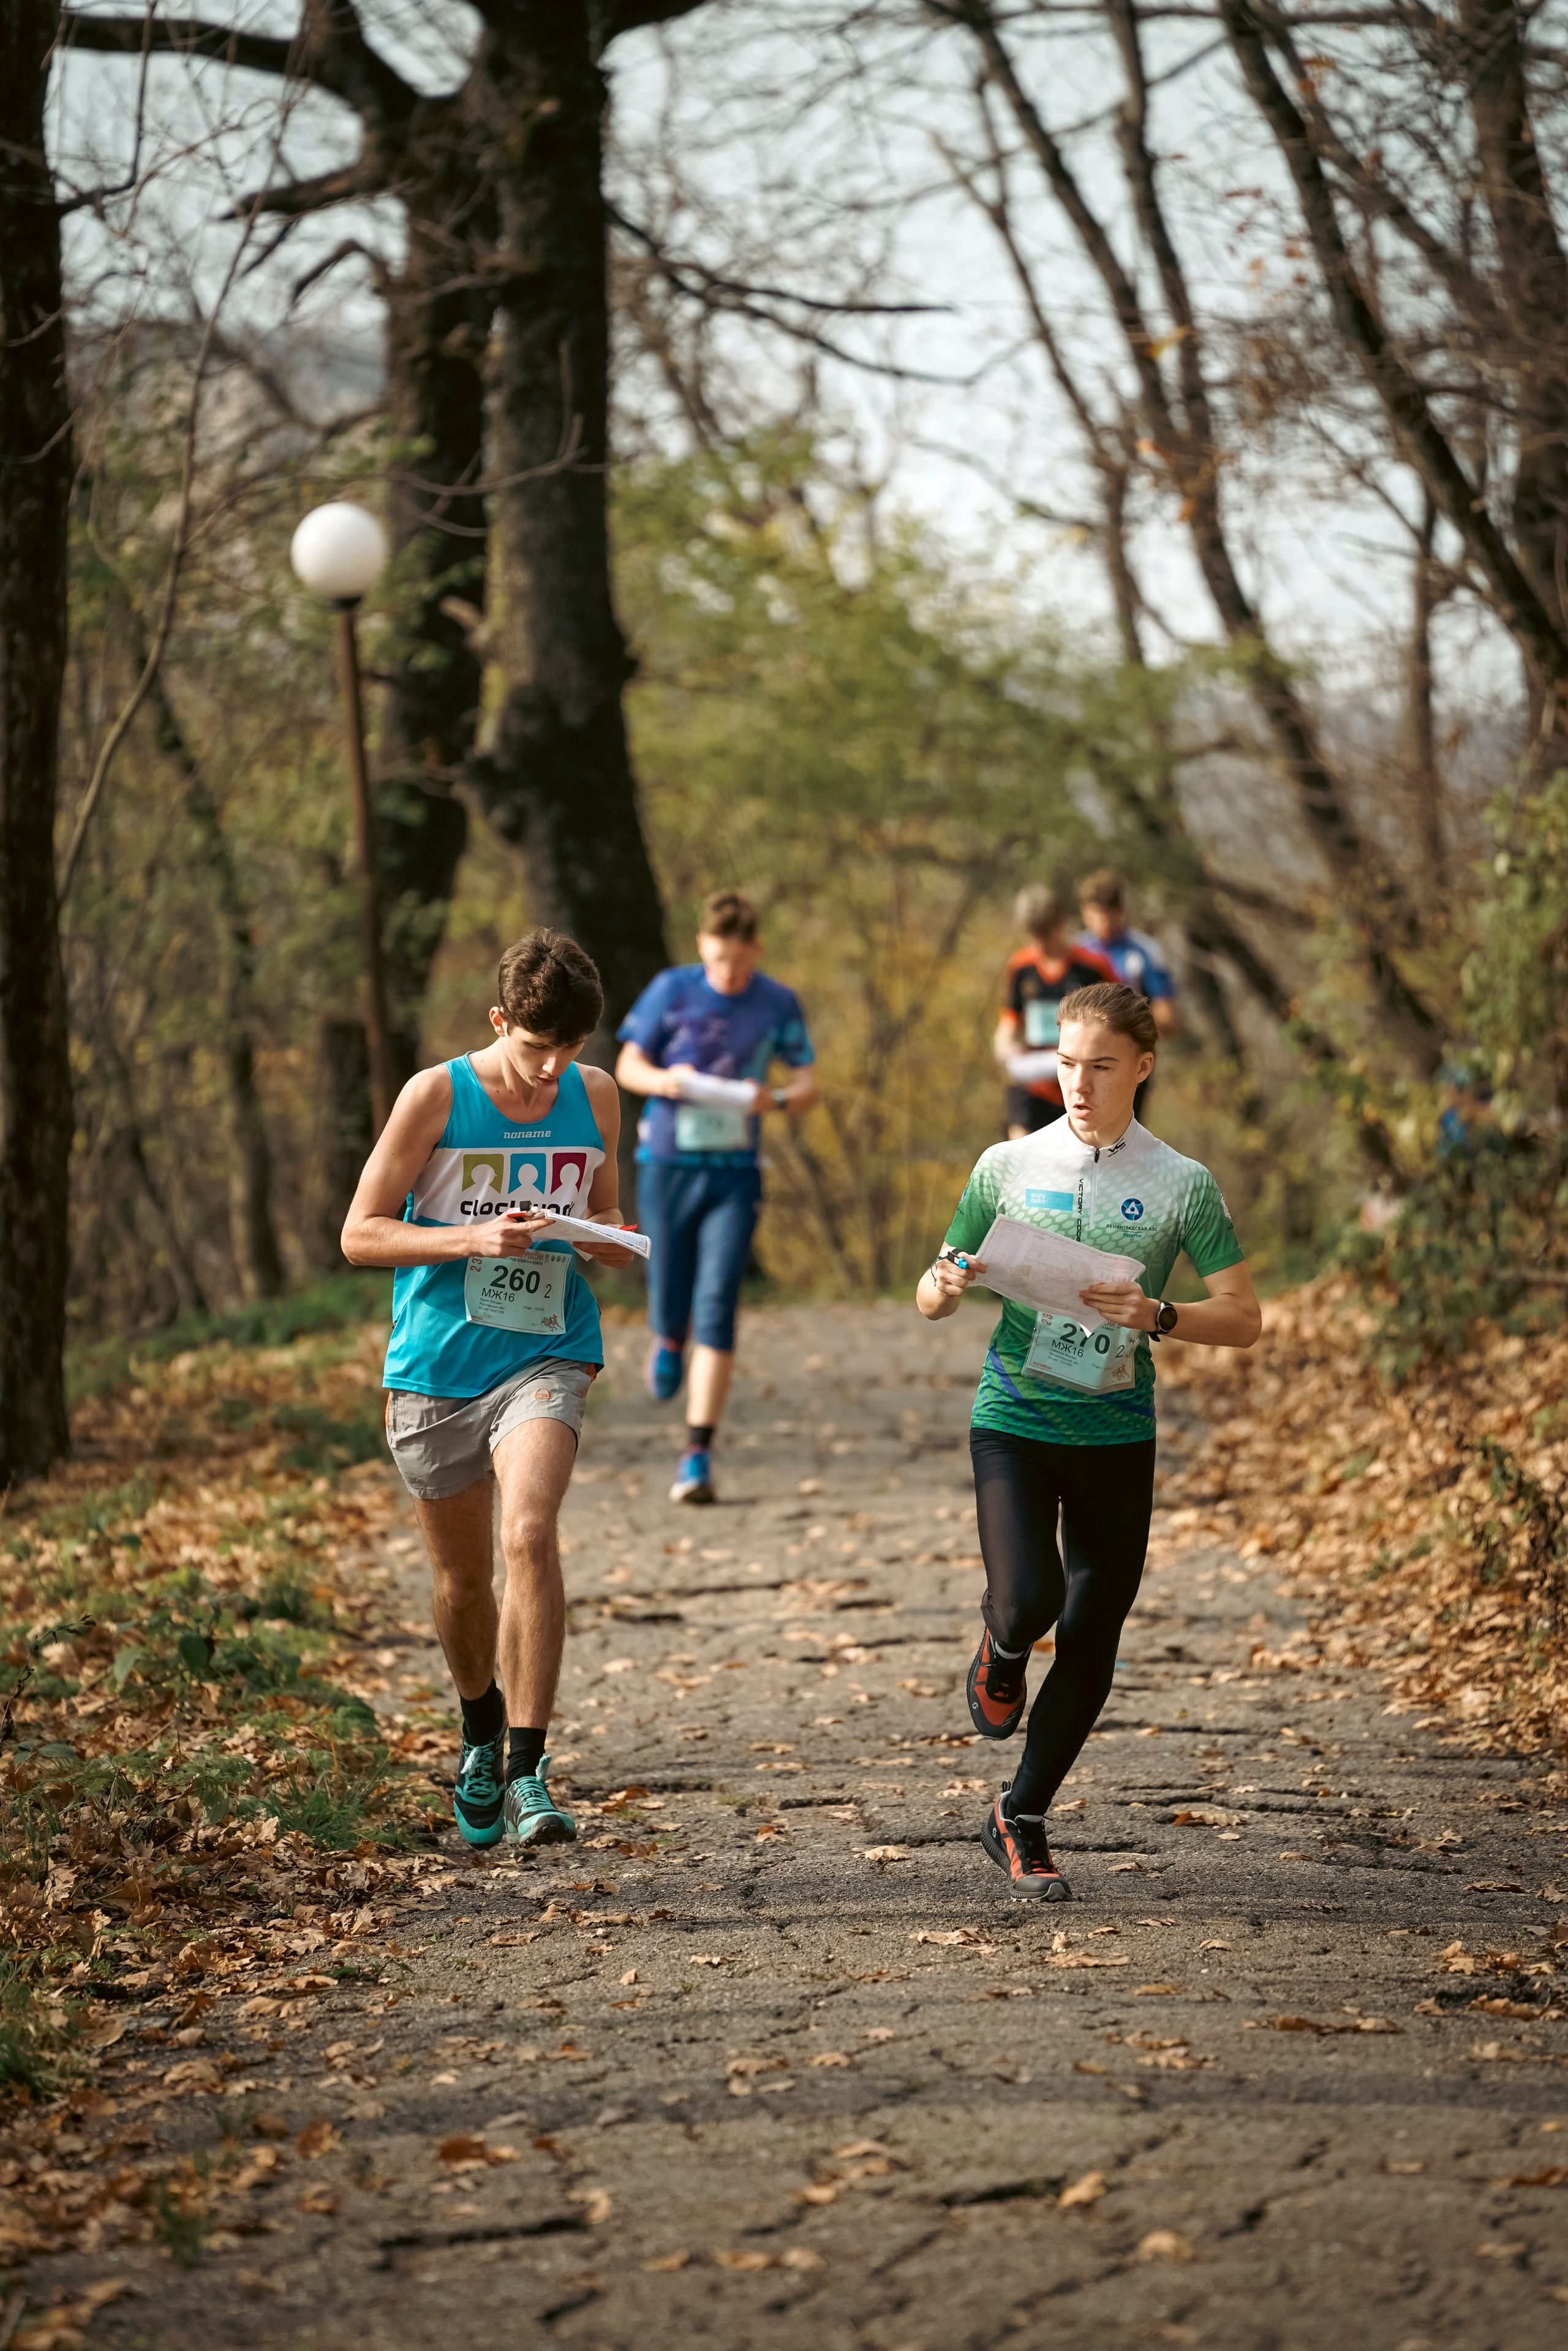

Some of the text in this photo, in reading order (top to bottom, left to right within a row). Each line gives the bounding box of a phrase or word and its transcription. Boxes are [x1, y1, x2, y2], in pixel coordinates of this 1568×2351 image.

[503, 1130, 551, 1139] noname
[524, 1251, 544, 1261] РОССИИ
[490, 1265, 540, 1294] 260
[481, 1288, 515, 1302] МЖ16
[544, 1284, 551, 1299] 2
[1060, 1323, 1110, 1355] 270
[1051, 1340, 1084, 1357] МЖ16
[1115, 1345, 1125, 1359] 2
